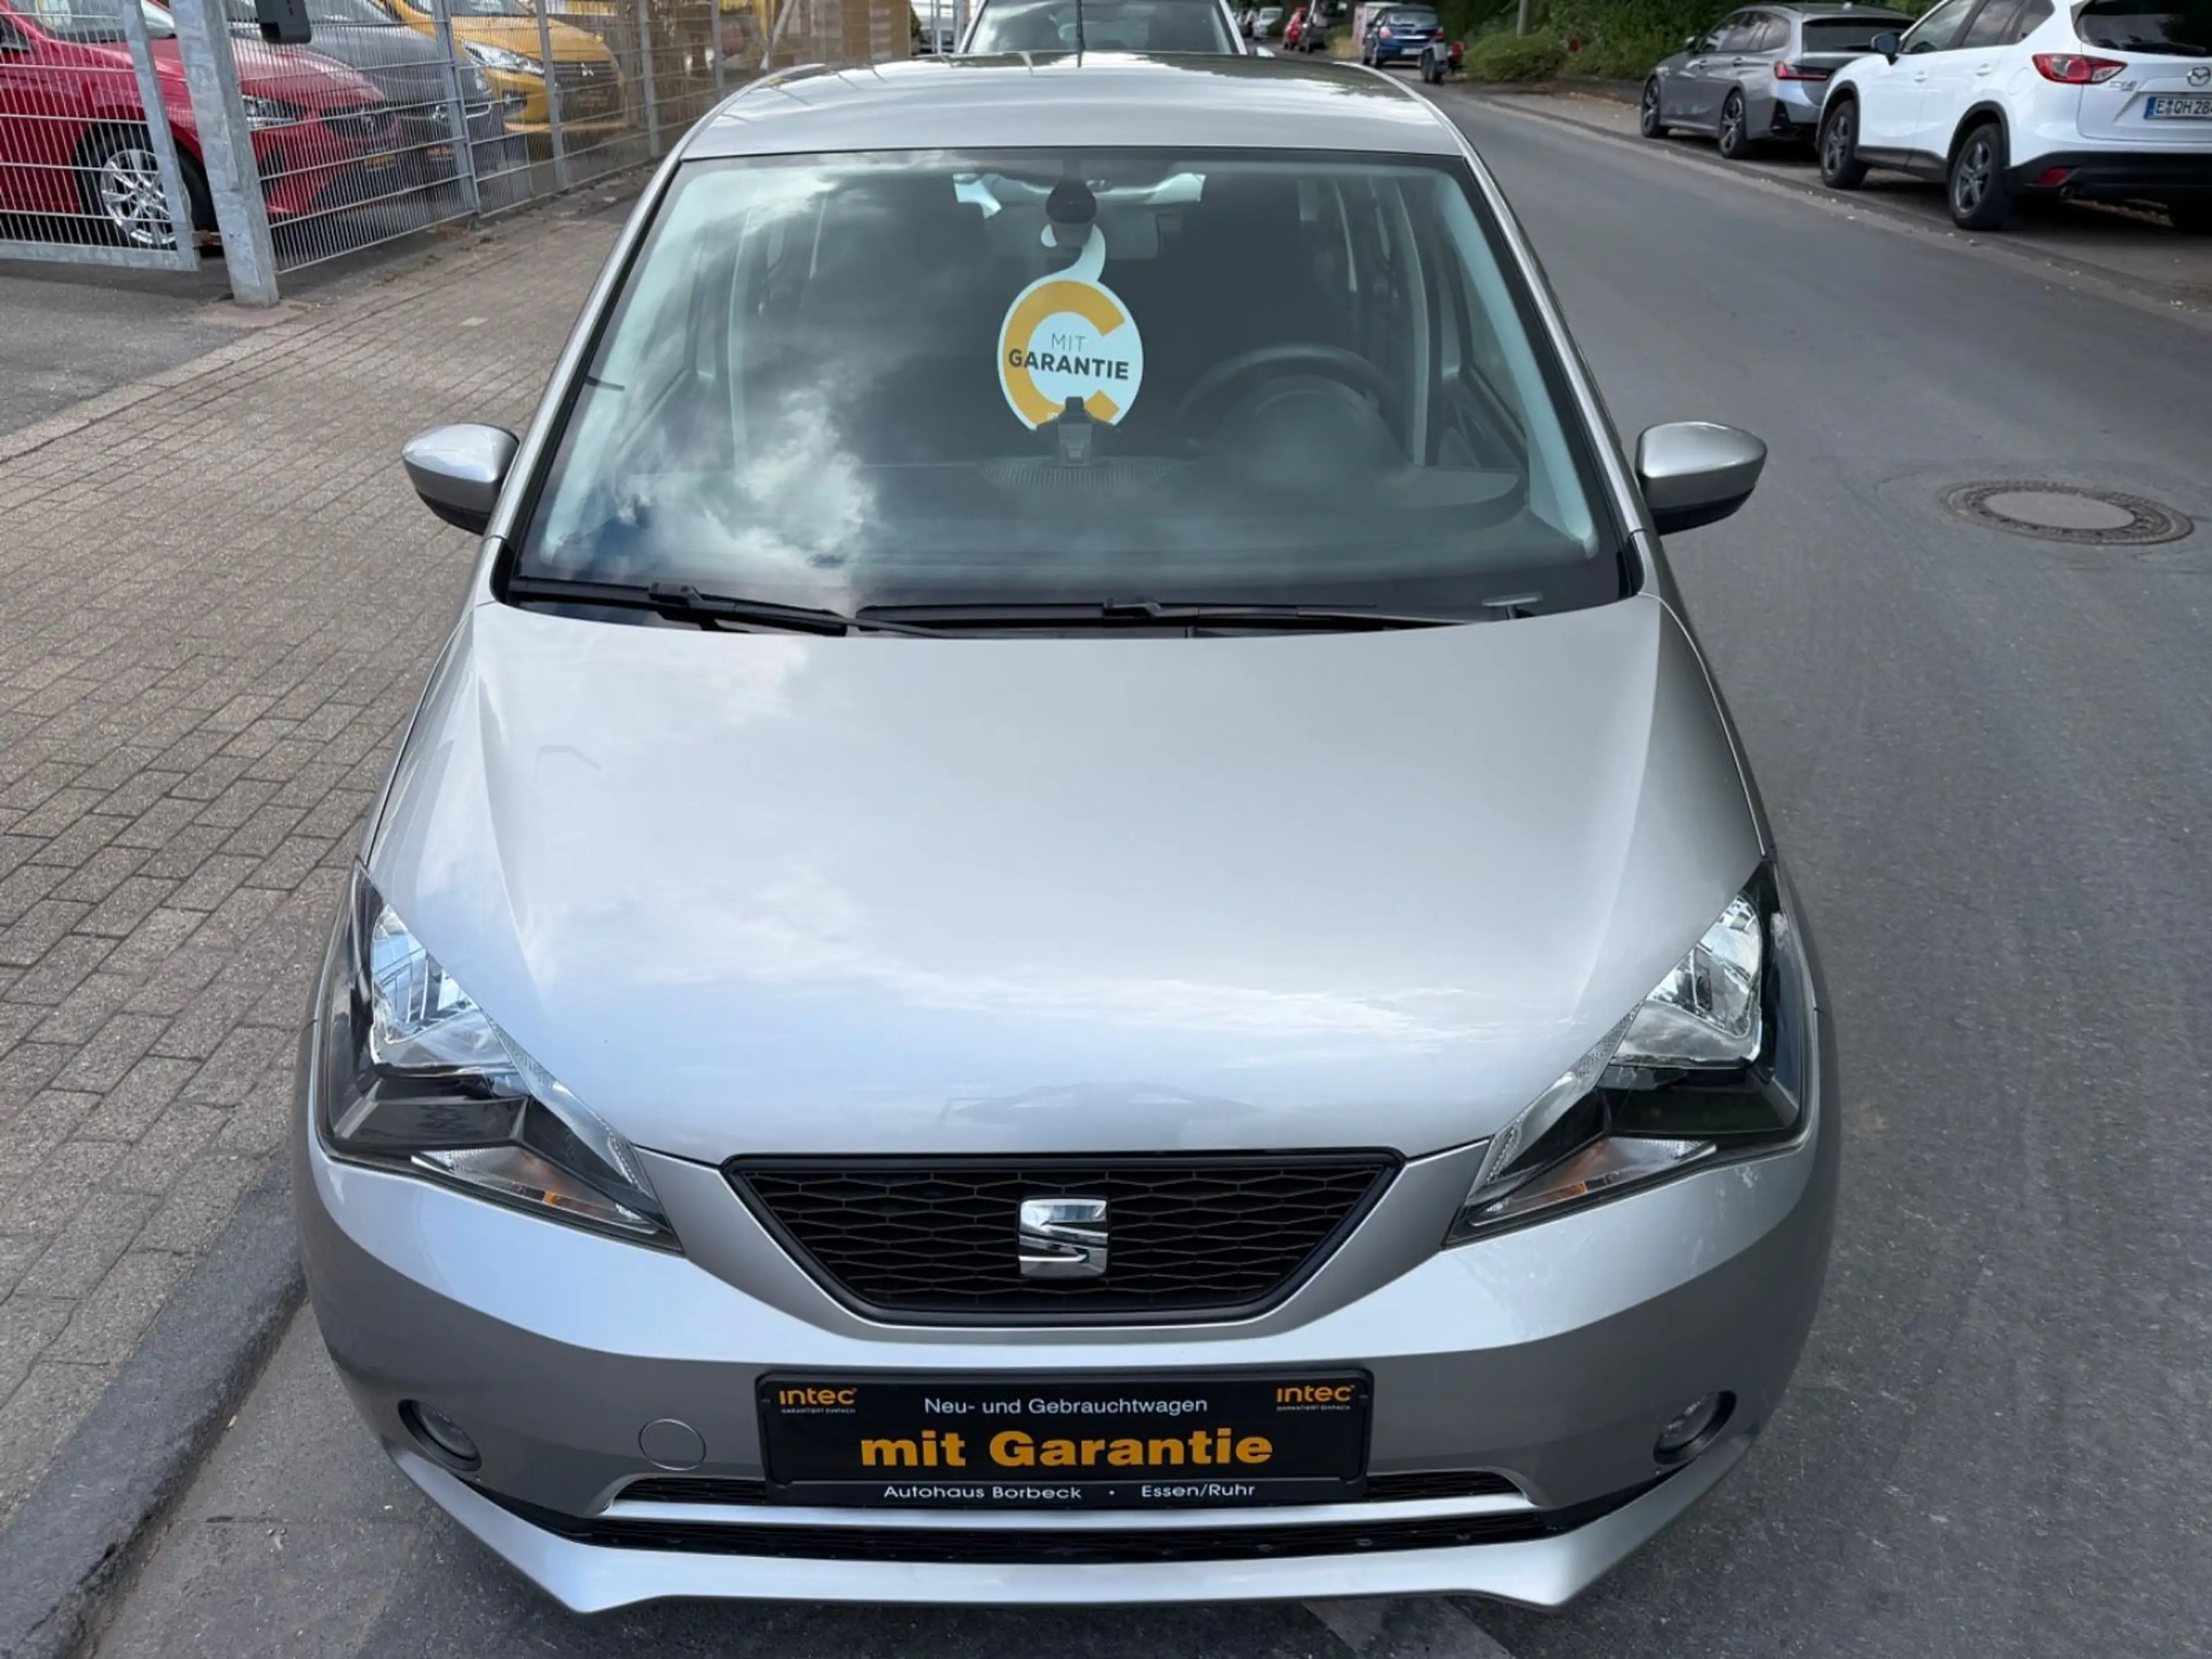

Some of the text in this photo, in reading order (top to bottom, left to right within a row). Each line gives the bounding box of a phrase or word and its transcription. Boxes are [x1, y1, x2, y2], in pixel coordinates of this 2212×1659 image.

[2156, 100, 2166, 114] E
[1051, 332, 1086, 353] MIT
[1008, 348, 1129, 381] GARANTIE
[779, 1388, 854, 1405] intec
[1277, 1385, 1351, 1402] intec
[925, 1397, 1208, 1416] Neu- und Gebrauchtwagen
[861, 1427, 1273, 1467] mit Garantie
[884, 1483, 1255, 1499] Autohaus Borbeck Essen/Ruhr
